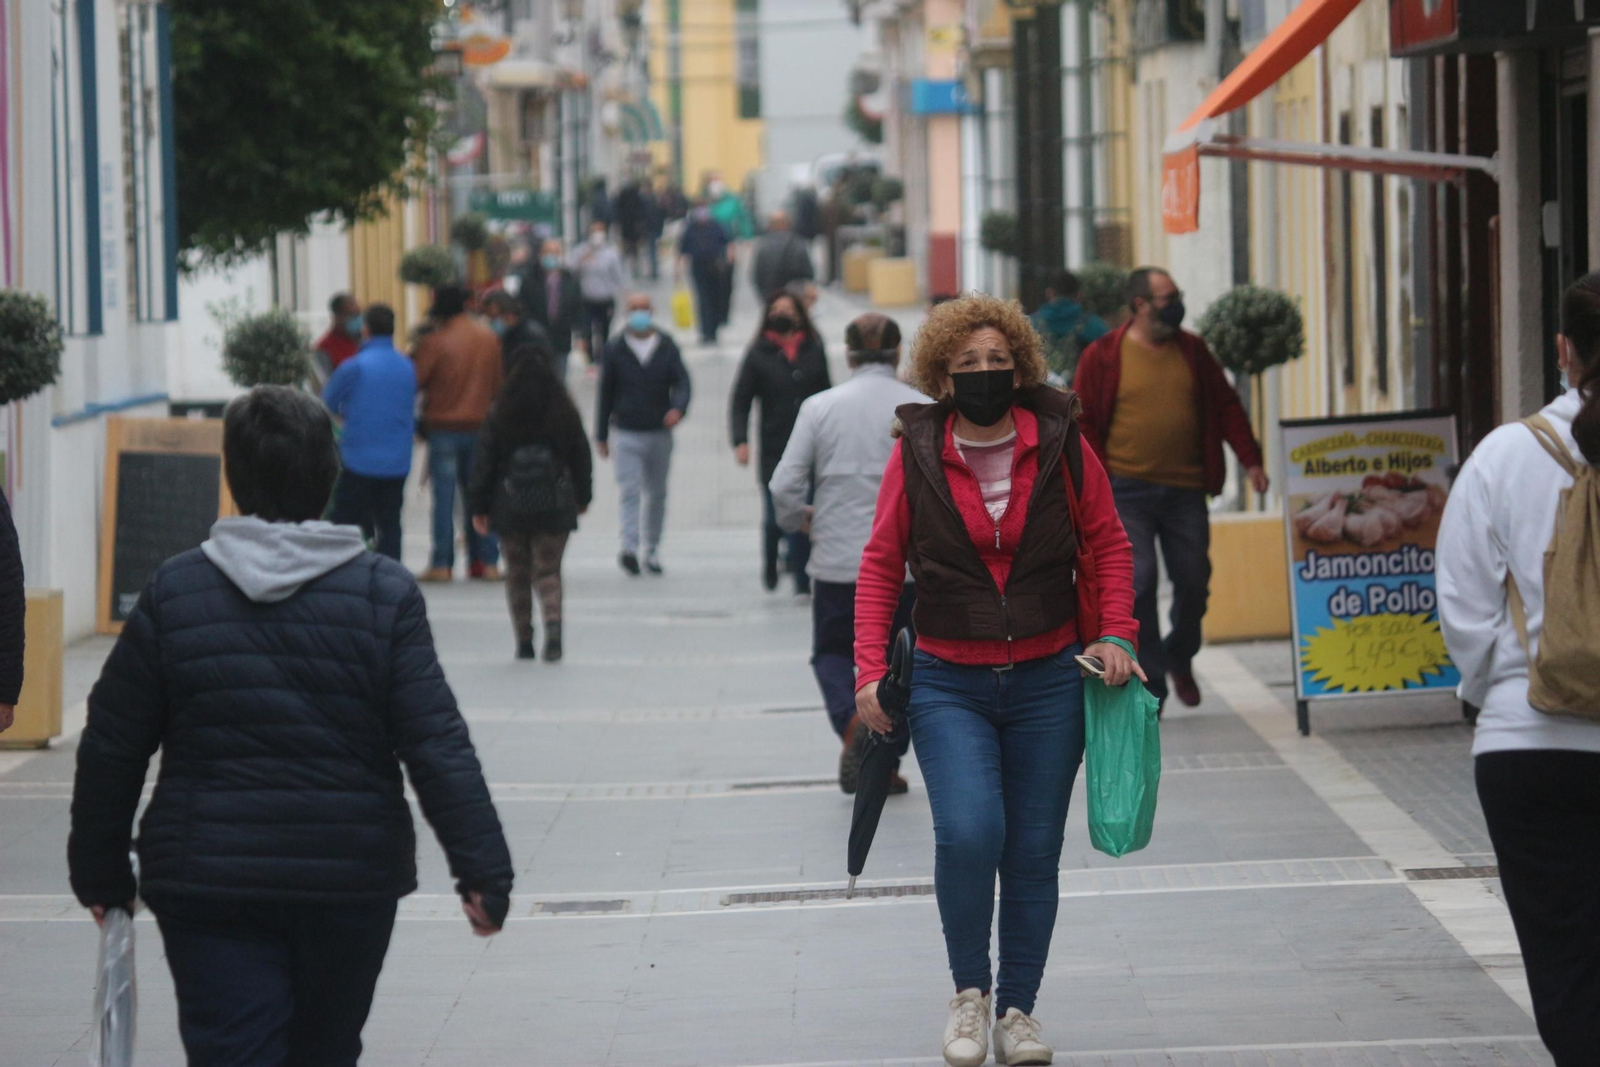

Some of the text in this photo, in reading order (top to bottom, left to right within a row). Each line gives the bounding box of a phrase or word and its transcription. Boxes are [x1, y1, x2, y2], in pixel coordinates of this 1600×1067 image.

[1305, 452, 1433, 475] Alberto e Hijos
[1300, 545, 1436, 580] Jamoncito
[1330, 583, 1436, 616] de Pollo
